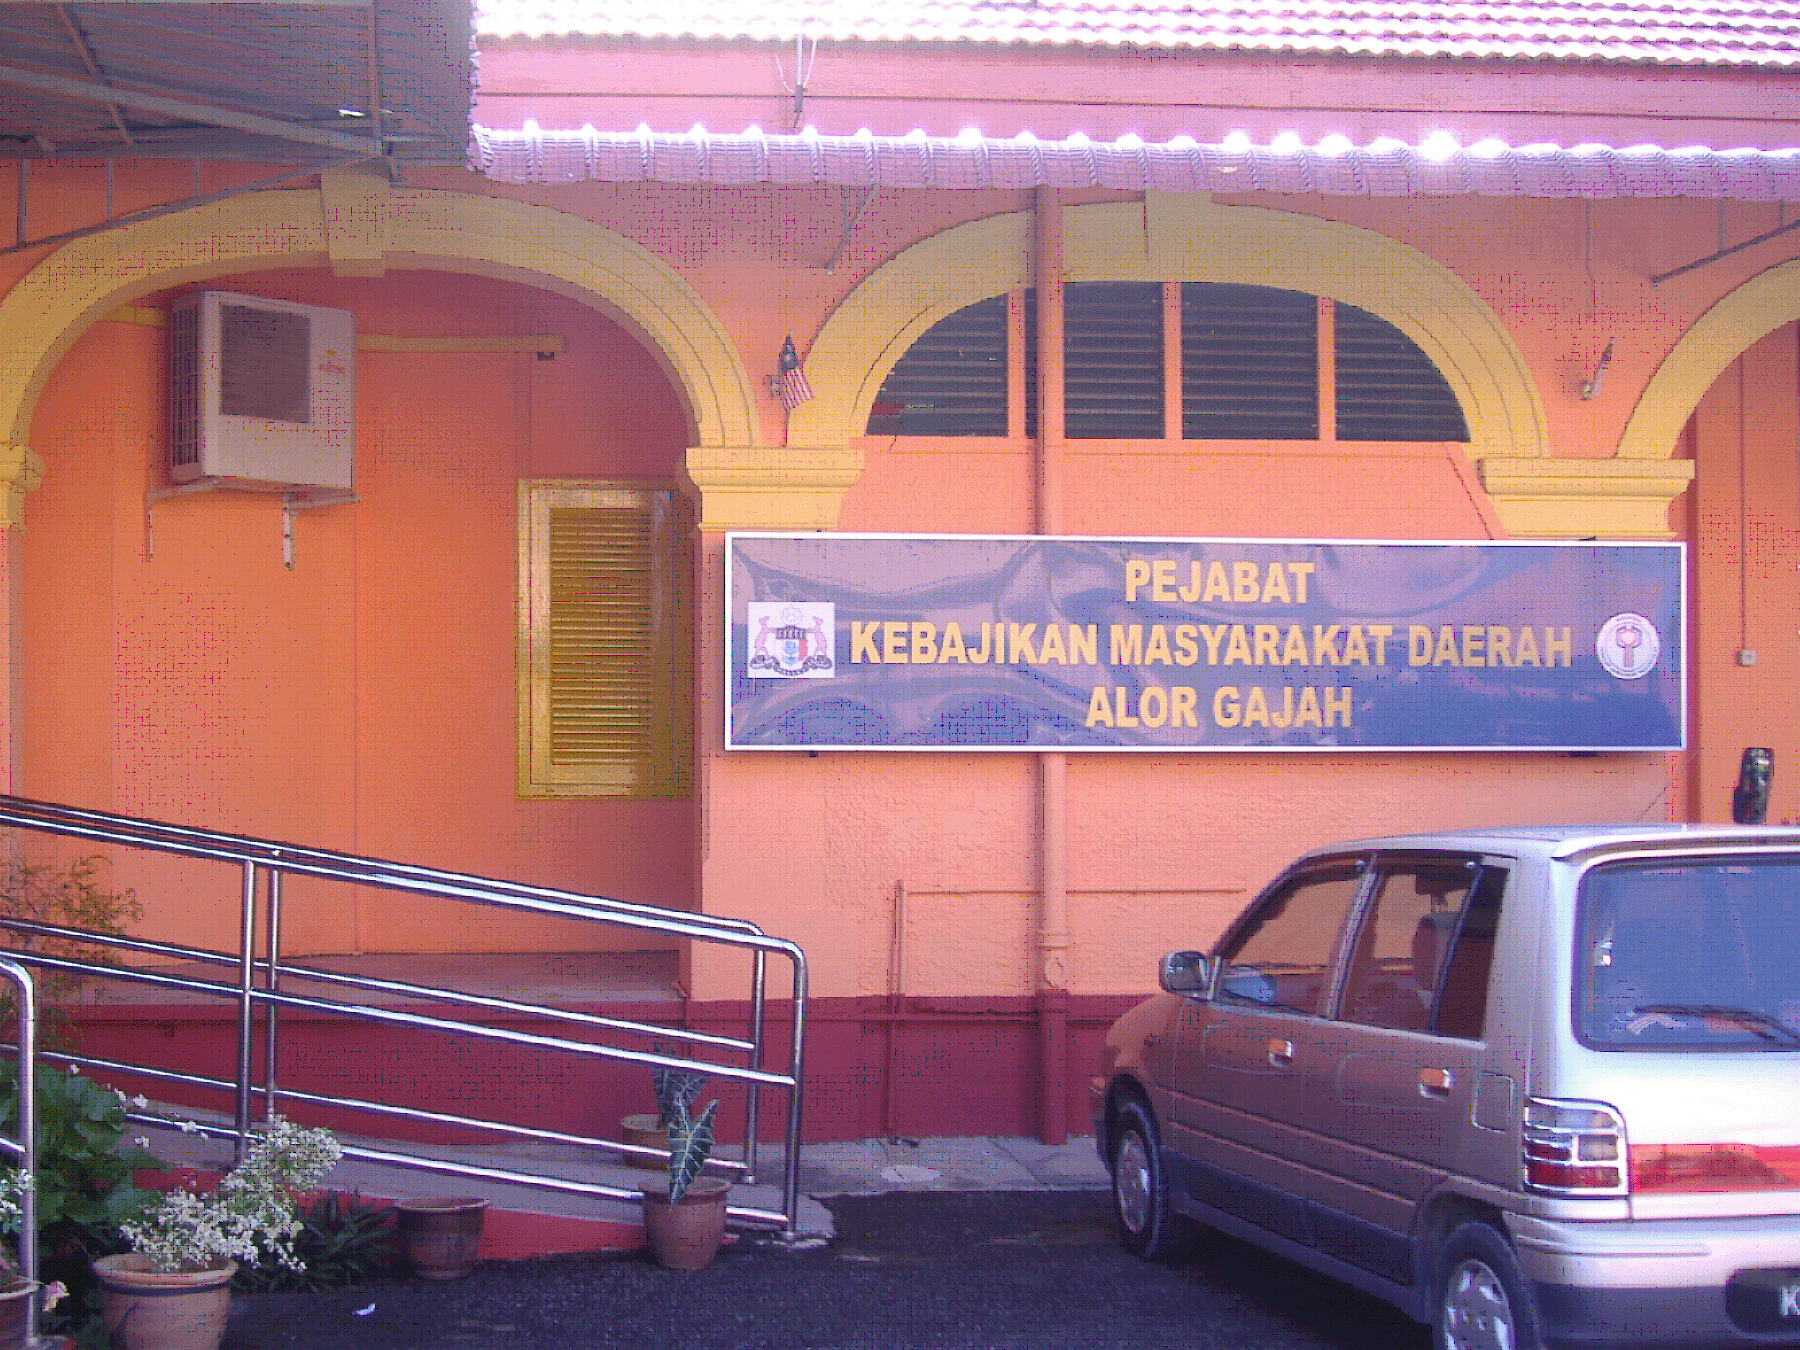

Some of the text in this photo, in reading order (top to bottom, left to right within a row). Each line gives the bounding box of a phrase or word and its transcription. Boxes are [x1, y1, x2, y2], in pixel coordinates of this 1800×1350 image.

[1126, 561, 1314, 603] PEJABAT
[850, 621, 1572, 668] KEBAJIKAN MASYARAKAT DAERAH
[1086, 686, 1353, 728] ALOR GAJAH
